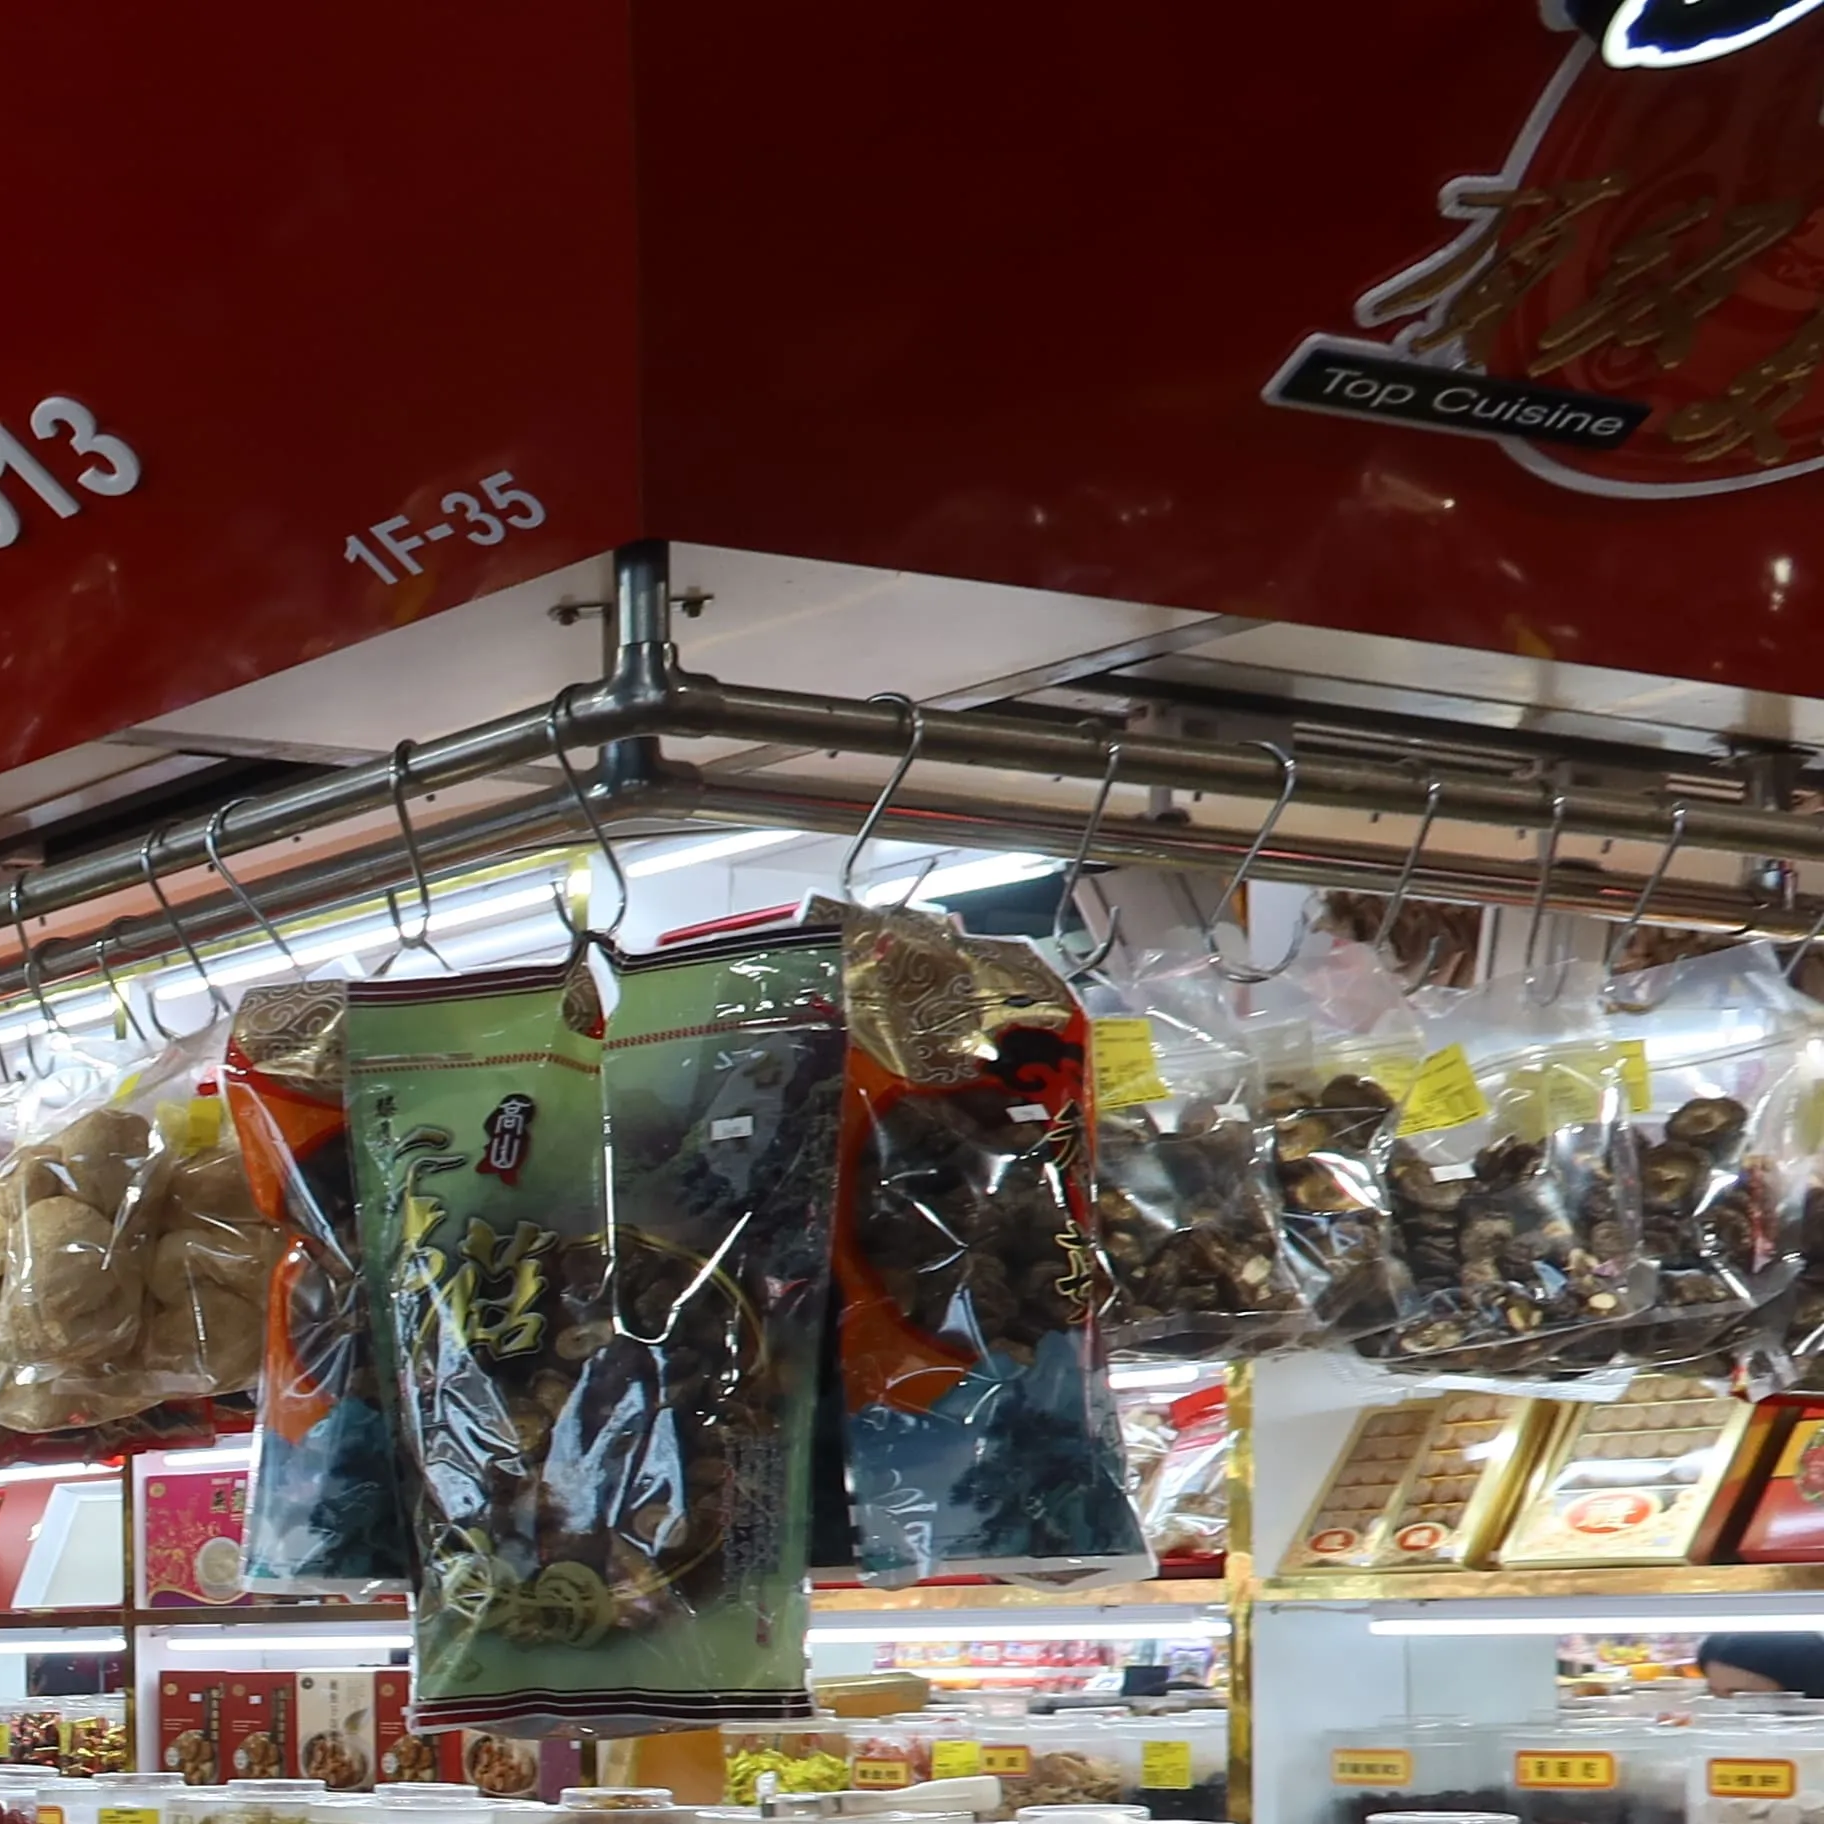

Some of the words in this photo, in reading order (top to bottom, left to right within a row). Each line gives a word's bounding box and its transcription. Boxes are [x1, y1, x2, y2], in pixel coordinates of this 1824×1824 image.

[1321, 366, 1414, 408] Top
[1432, 386, 1625, 437] Cuisine
[343, 470, 546, 588] 1F-35
[490, 1099, 531, 1169] 高山
